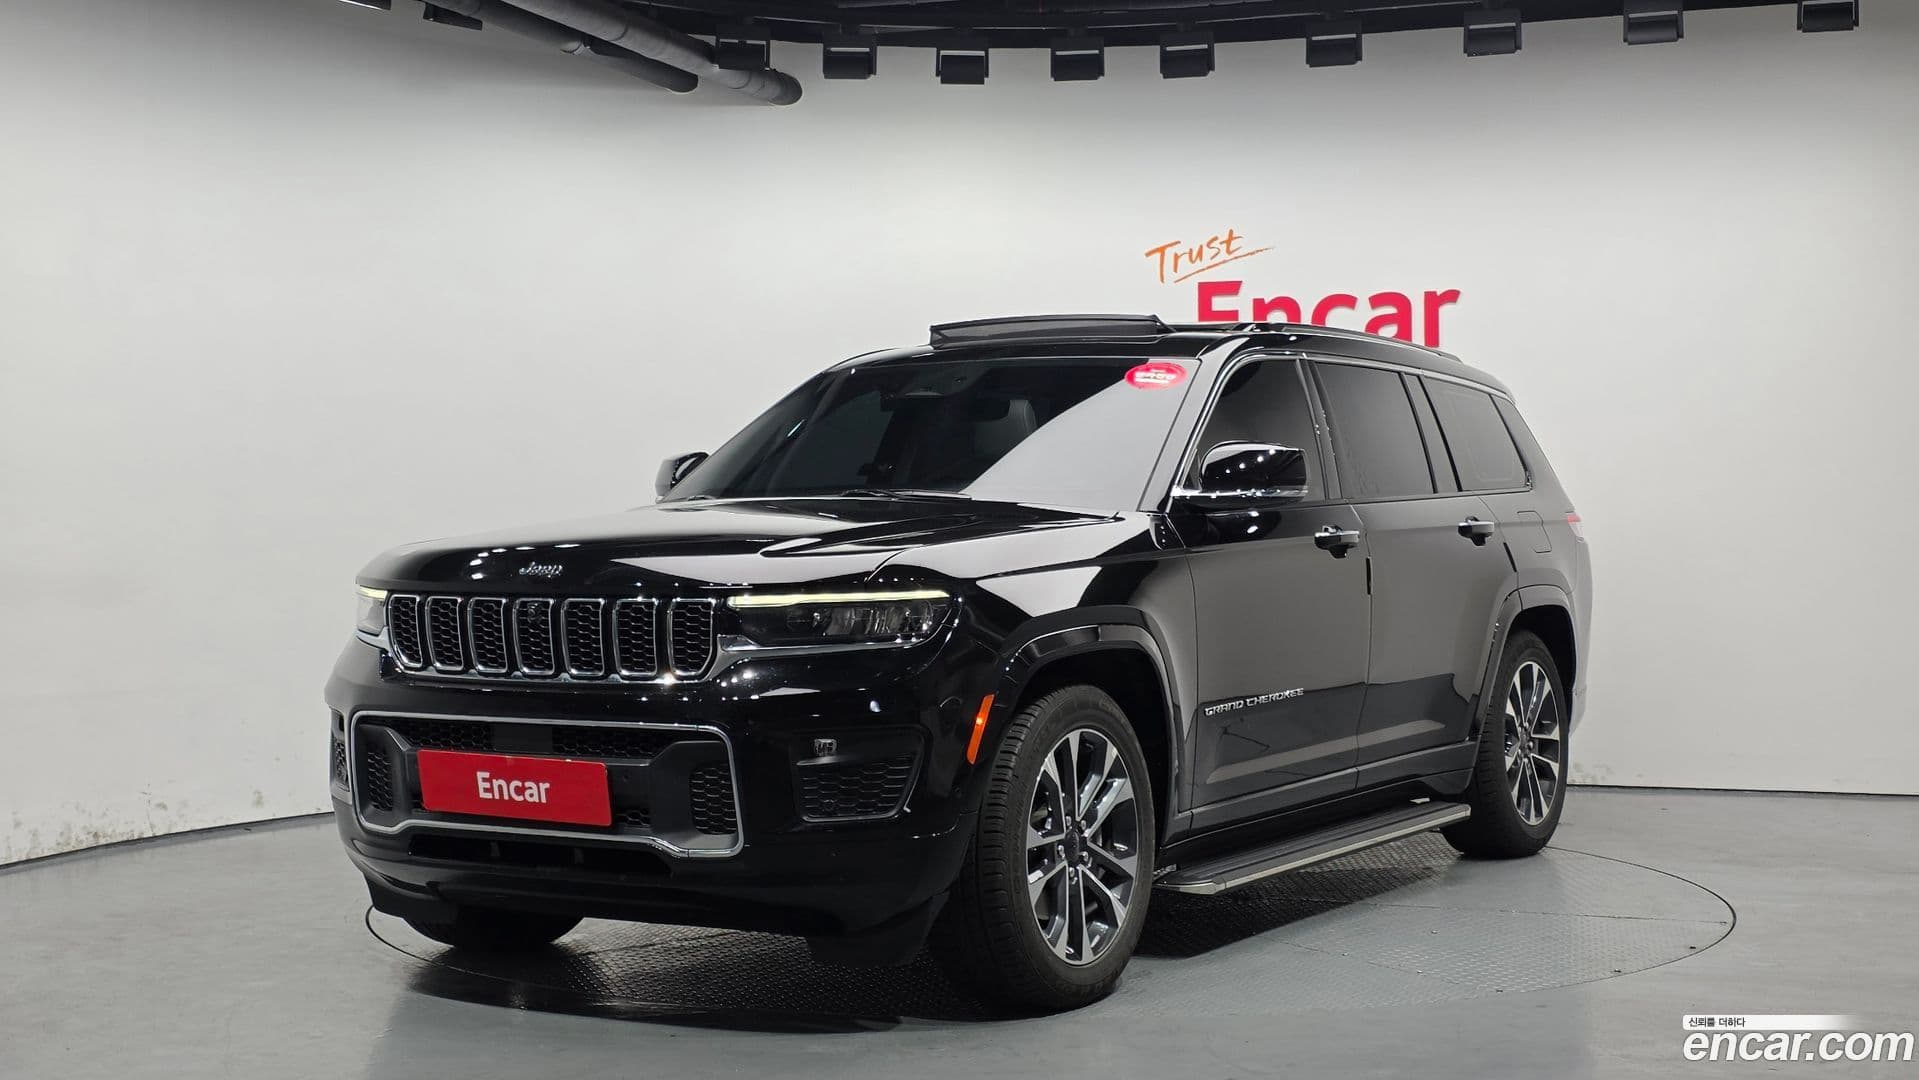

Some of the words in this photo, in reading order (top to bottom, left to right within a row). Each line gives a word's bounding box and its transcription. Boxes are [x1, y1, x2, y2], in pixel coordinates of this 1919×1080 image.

[1145, 229, 1244, 283] Trust
[1197, 280, 1461, 348] Encar
[519, 561, 563, 580] Jeep
[1204, 700, 1244, 716] GRAND
[1246, 688, 1304, 707] CHEROKEE
[476, 771, 550, 804] Encar
